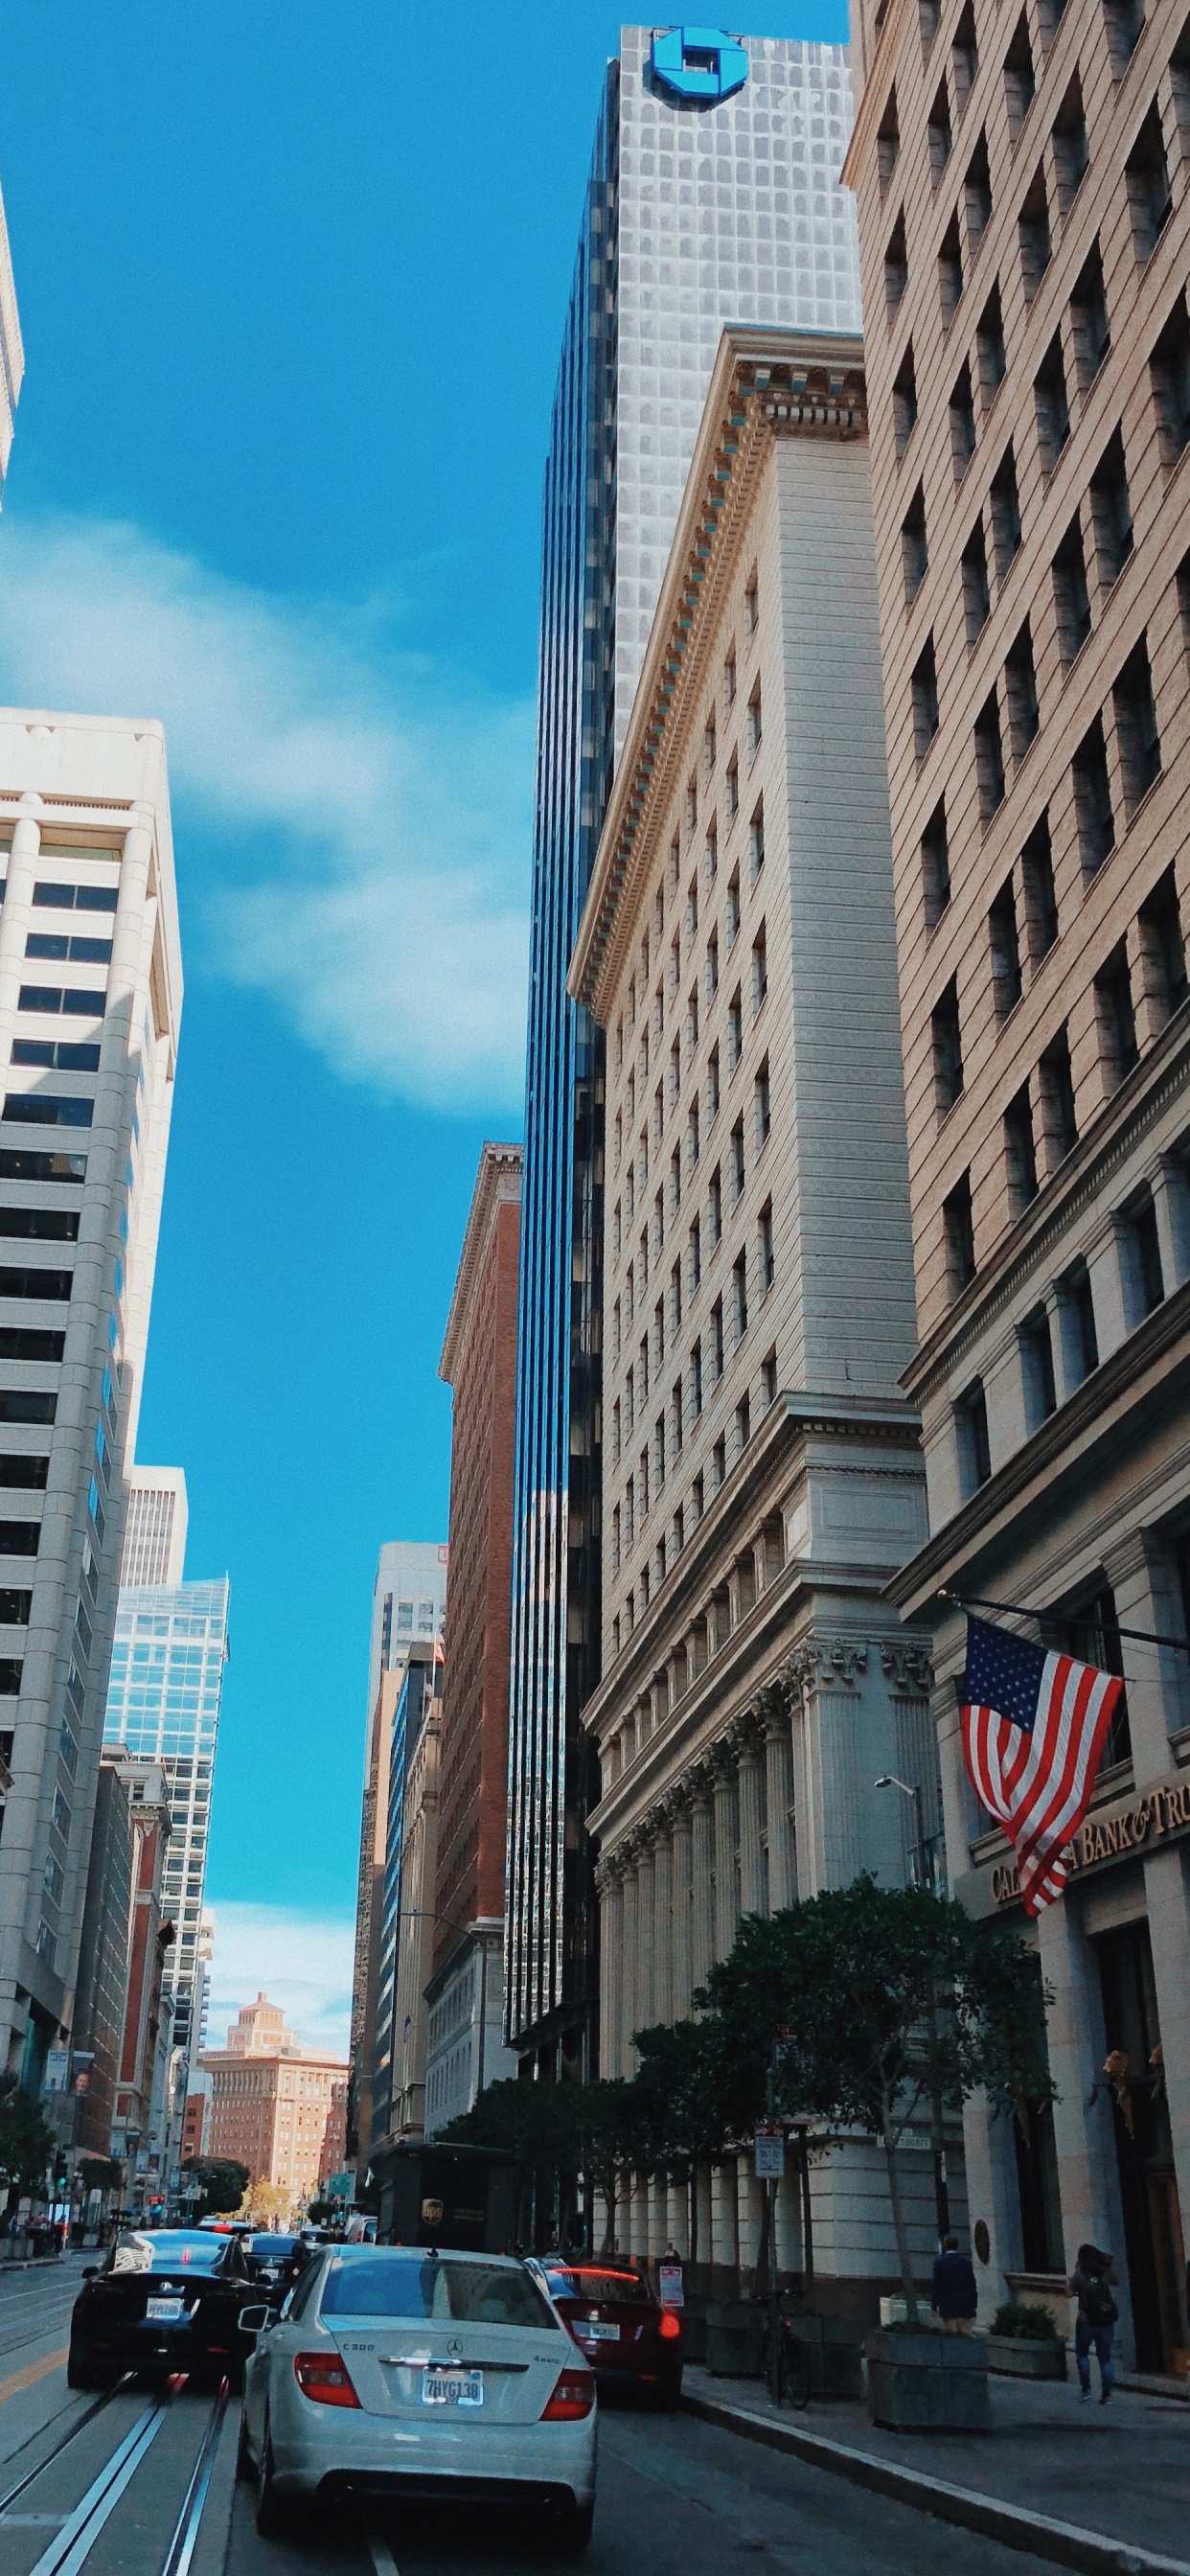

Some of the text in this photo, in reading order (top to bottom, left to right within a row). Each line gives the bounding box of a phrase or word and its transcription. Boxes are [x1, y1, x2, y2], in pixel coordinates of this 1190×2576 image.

[1082, 1812, 1133, 1865] BANK
[1132, 1799, 1150, 1843] &
[352, 2343, 375, 2352] 300
[426, 2380, 479, 2400] 7HYG138
